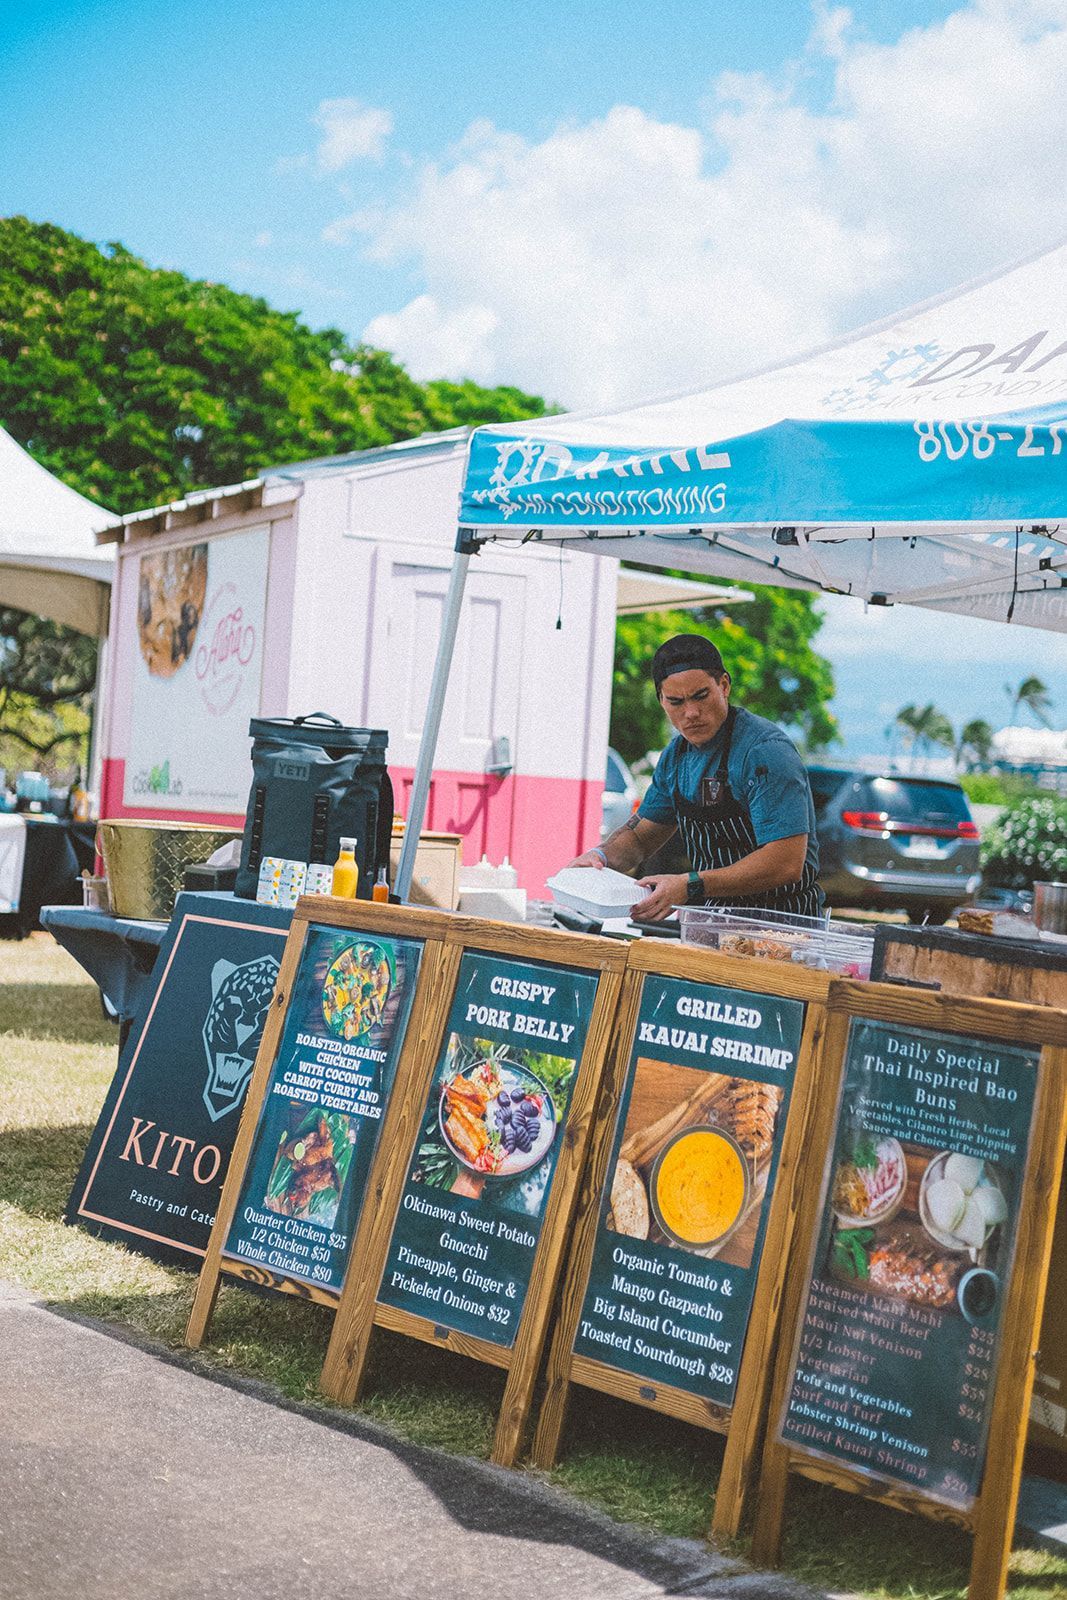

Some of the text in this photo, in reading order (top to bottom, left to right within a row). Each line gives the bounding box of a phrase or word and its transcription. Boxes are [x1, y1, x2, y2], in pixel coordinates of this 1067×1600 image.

[933, 379, 1067, 401] CONDIT
[551, 482, 727, 517] CONDITIONING
[278, 761, 307, 778] YETI
[490, 975, 556, 1005] CRISPY
[465, 1003, 575, 1044] PORK BELLY
[676, 996, 762, 1030] GRILLED
[295, 1033, 388, 1063] ROASTED ORGANIC
[316, 1051, 361, 1071] CHICKEN
[638, 1022, 794, 1071] KAUAI SHRIMP
[887, 1038, 1000, 1076] Daily Special
[283, 1072, 379, 1104] CARROT CURRY AND
[298, 1061, 372, 1088] WITH COCONUT
[863, 1055, 1018, 1102] Thai Inspired Bao
[273, 1083, 382, 1119] ROASTED VEGETABLES
[859, 1095, 893, 1111] Served
[895, 1104, 916, 1117] with
[919, 1108, 945, 1123] Fresh
[983, 1123, 1010, 1138] Local
[915, 1087, 957, 1111] Buns
[119, 1116, 224, 1189] KITO
[862, 1120, 999, 1162] Sauce and Choice of Protein
[906, 1118, 947, 1136] Cilantro
[950, 1128, 973, 1142] Lime
[976, 1134, 1017, 1154] Dipping
[129, 1189, 164, 1212] Pastry
[166, 1205, 188, 1217] and
[403, 1194, 536, 1248] Okinawa Sweet Potato
[244, 1206, 347, 1250] Quarter Chicken $25
[250, 1226, 331, 1263] 1/2 Chicken $50
[439, 1232, 489, 1261] Gnocchi
[236, 1239, 332, 1283] Whole Chicken $80
[397, 1246, 517, 1299] Pineapple, Ginger &
[612, 1247, 733, 1297] Organic Tomato &
[390, 1271, 511, 1325] Pickeled Onions $32
[611, 1274, 723, 1323] Mango Gazpacho
[808, 1294, 859, 1319] Braised
[862, 1310, 896, 1330] Maui
[900, 1321, 931, 1341] Beef
[810, 1279, 868, 1306] Steamed
[872, 1297, 906, 1317] Mahi
[909, 1308, 943, 1329] Mahi
[593, 1297, 732, 1355] Big Island Cucumber
[805, 1313, 838, 1334] Maui
[869, 1332, 923, 1360] Venison
[581, 1320, 734, 1385] Toasted Sourdough $28
[799, 1351, 869, 1385] Vegetarian
[802, 1333, 823, 1349] 1/2
[827, 1340, 877, 1366] Lobster
[792, 1385, 823, 1404] Surf
[824, 1398, 848, 1413] and
[852, 1404, 884, 1424] Turf
[796, 1369, 913, 1418] Tofu and Vegetables
[786, 1418, 832, 1444] Grilled
[835, 1435, 872, 1458] Kauai
[877, 1450, 927, 1479] Shrimp
[790, 1400, 929, 1458] Lobster Shrimp Venison
